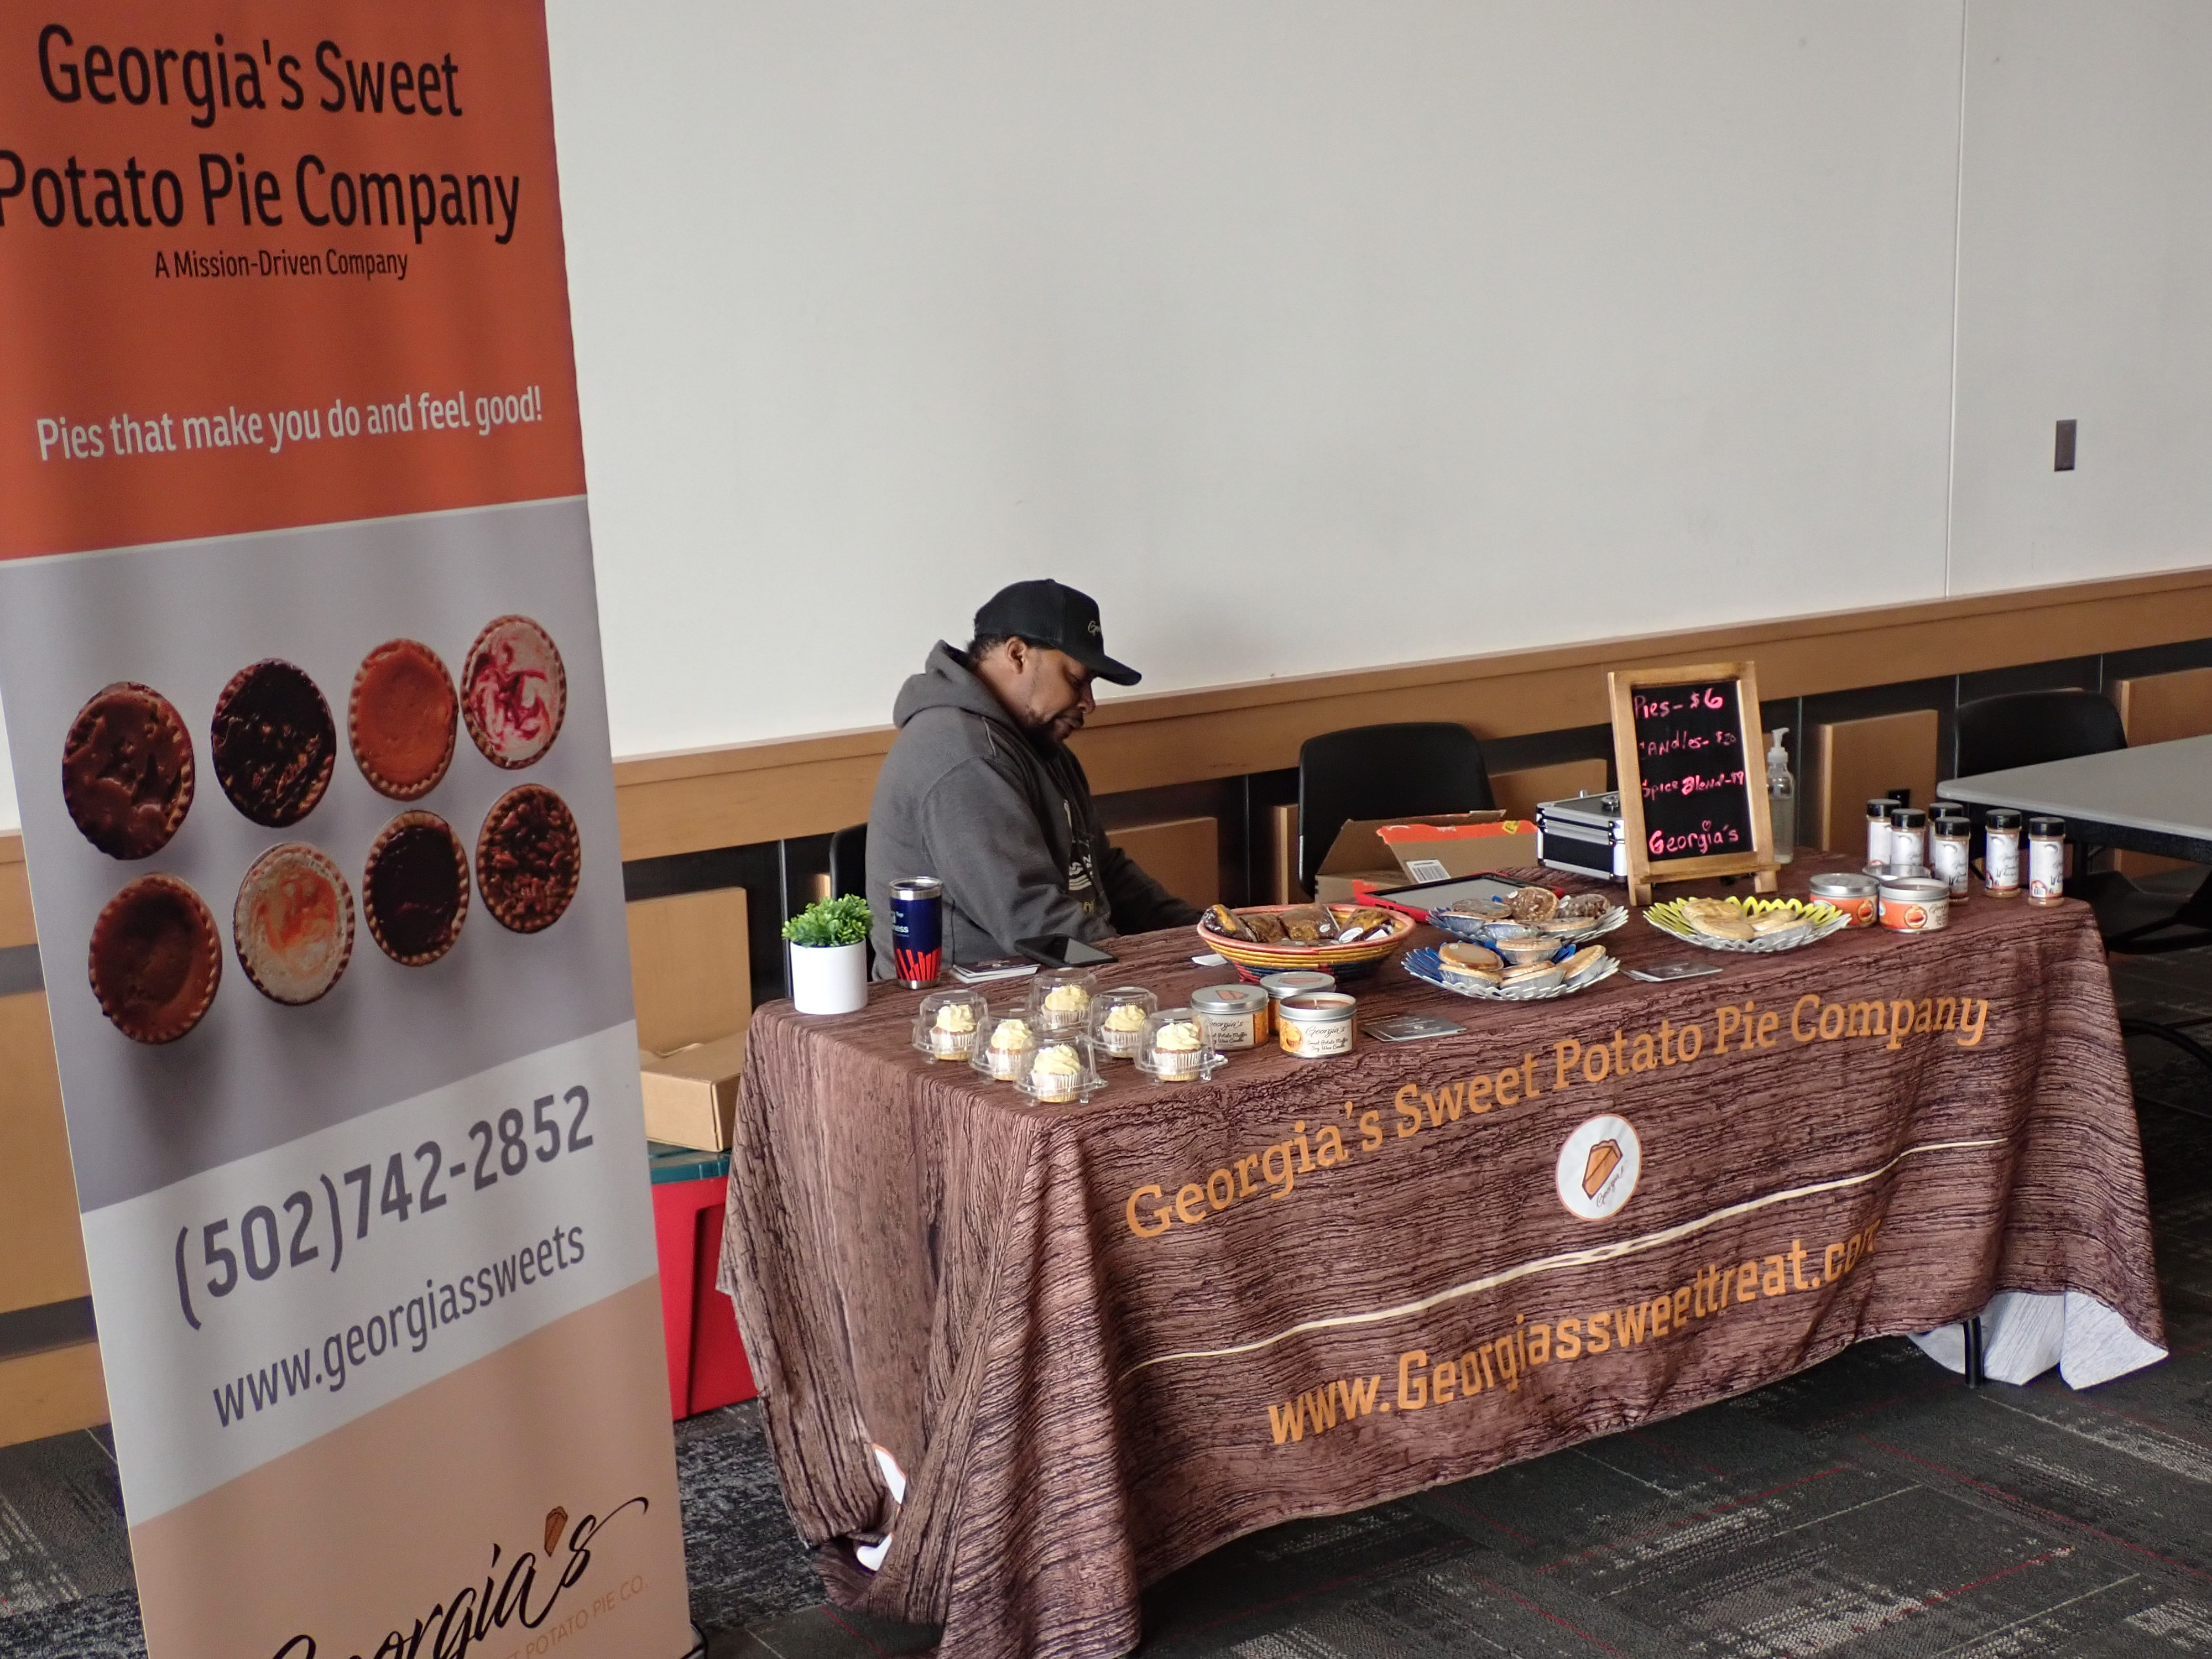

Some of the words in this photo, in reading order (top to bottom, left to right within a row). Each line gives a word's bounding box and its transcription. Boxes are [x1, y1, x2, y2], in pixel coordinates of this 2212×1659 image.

[38, 23, 304, 128] Georgia's
[315, 40, 463, 117] Sweet
[0, 149, 184, 228] Potato
[198, 152, 281, 228] Pie
[295, 153, 520, 245] Company
[155, 251, 170, 278] A
[174, 249, 322, 278] Mission-Driven
[326, 248, 408, 281] Company
[36, 416, 105, 461] Pies
[109, 413, 177, 455] that
[182, 405, 264, 450] make
[268, 409, 321, 453] you
[327, 398, 361, 438] do
[367, 393, 414, 435] and
[418, 390, 471, 430] feel
[475, 385, 542, 436] good!
[1649, 820, 1739, 854] Georgia's
[1126, 1100, 1383, 1238] Georgia's
[1394, 1053, 1540, 1138] Sweet
[1552, 1019, 1703, 1090] Potato
[1713, 1000, 1780, 1055] Pie
[1791, 994, 1988, 1050] Company
[175, 1084, 594, 1331] (502)742-2852
[213, 1226, 586, 1427] www.georgiassweets
[593, 1592, 615, 1620] PIE
